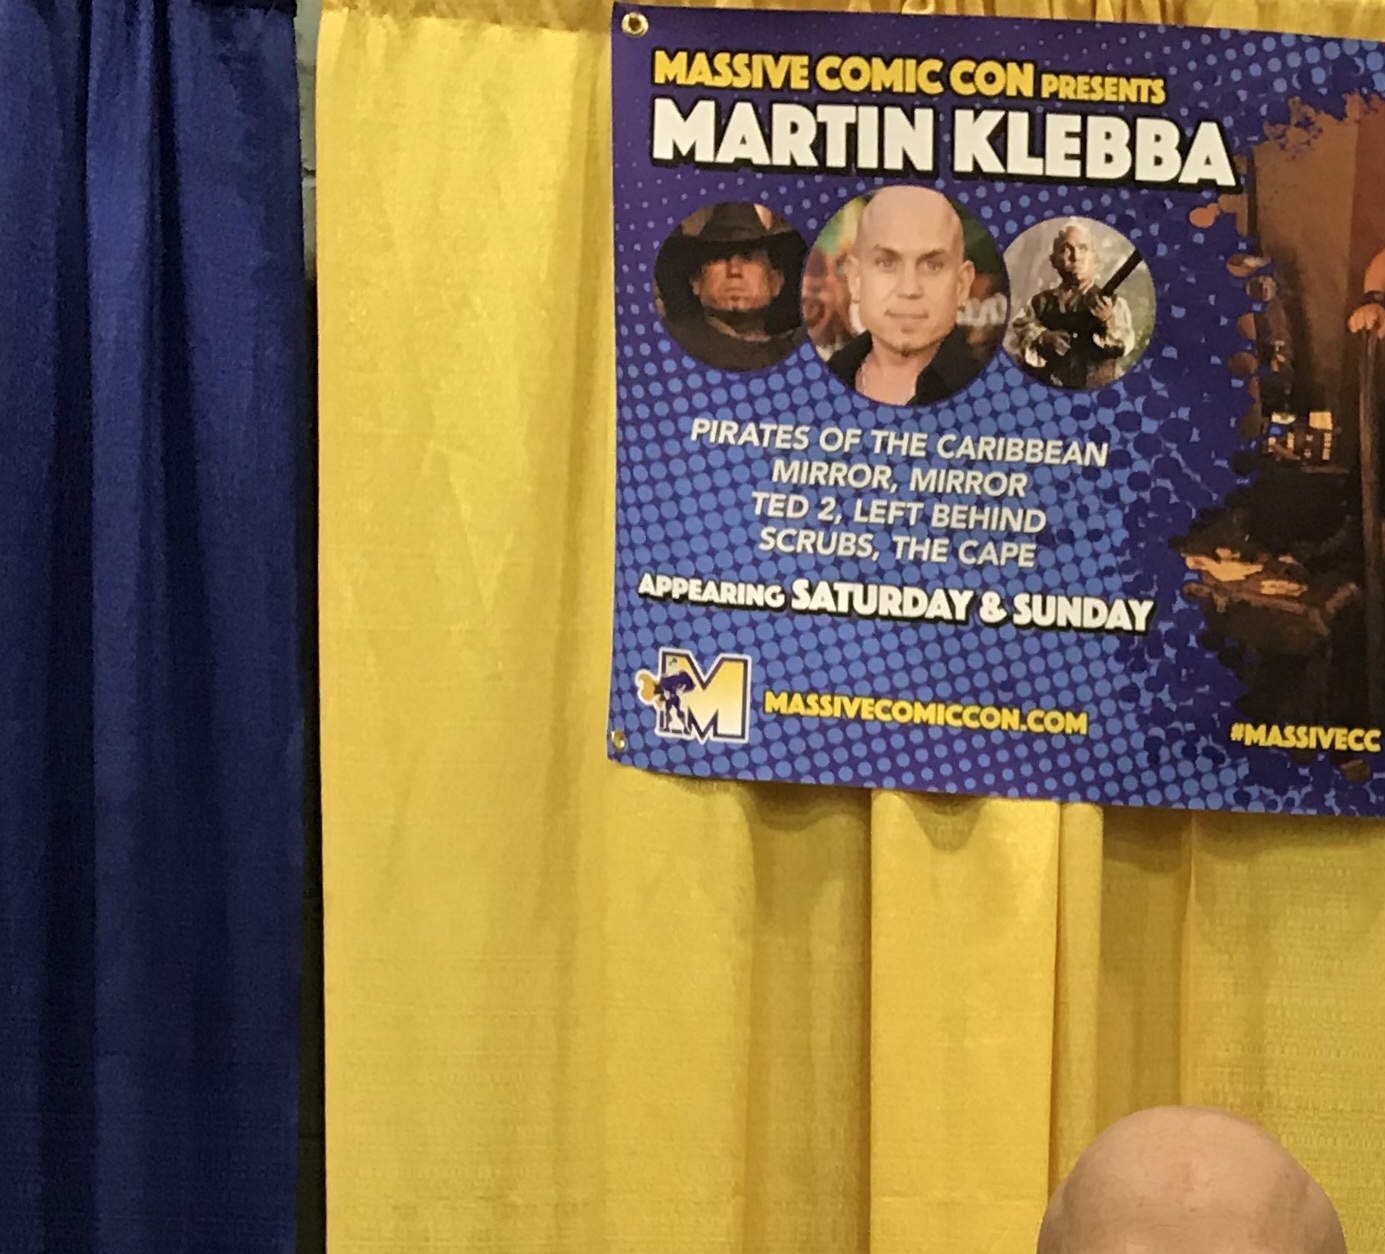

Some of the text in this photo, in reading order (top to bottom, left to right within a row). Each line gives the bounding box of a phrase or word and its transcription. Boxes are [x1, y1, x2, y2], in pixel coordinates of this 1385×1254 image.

[653, 49, 1166, 104] MASSIVE COMIC CON PRESENTS
[652, 98, 1238, 188] MARTIN KLEBBA
[690, 418, 1110, 467] PIRATES OF THE CARIBBEAN
[772, 459, 1028, 498] MIRROR, MIRROR
[752, 491, 1047, 535] TED 2, LEFT BEHIND
[759, 527, 1037, 568] SCRUBS, THE CAPE
[638, 573, 1155, 632] APPEARING SATURDAY & SUNDAY
[764, 690, 1089, 735] MASSIVECOMICCON.COM
[1230, 722, 1382, 752] #MASSIVECC
